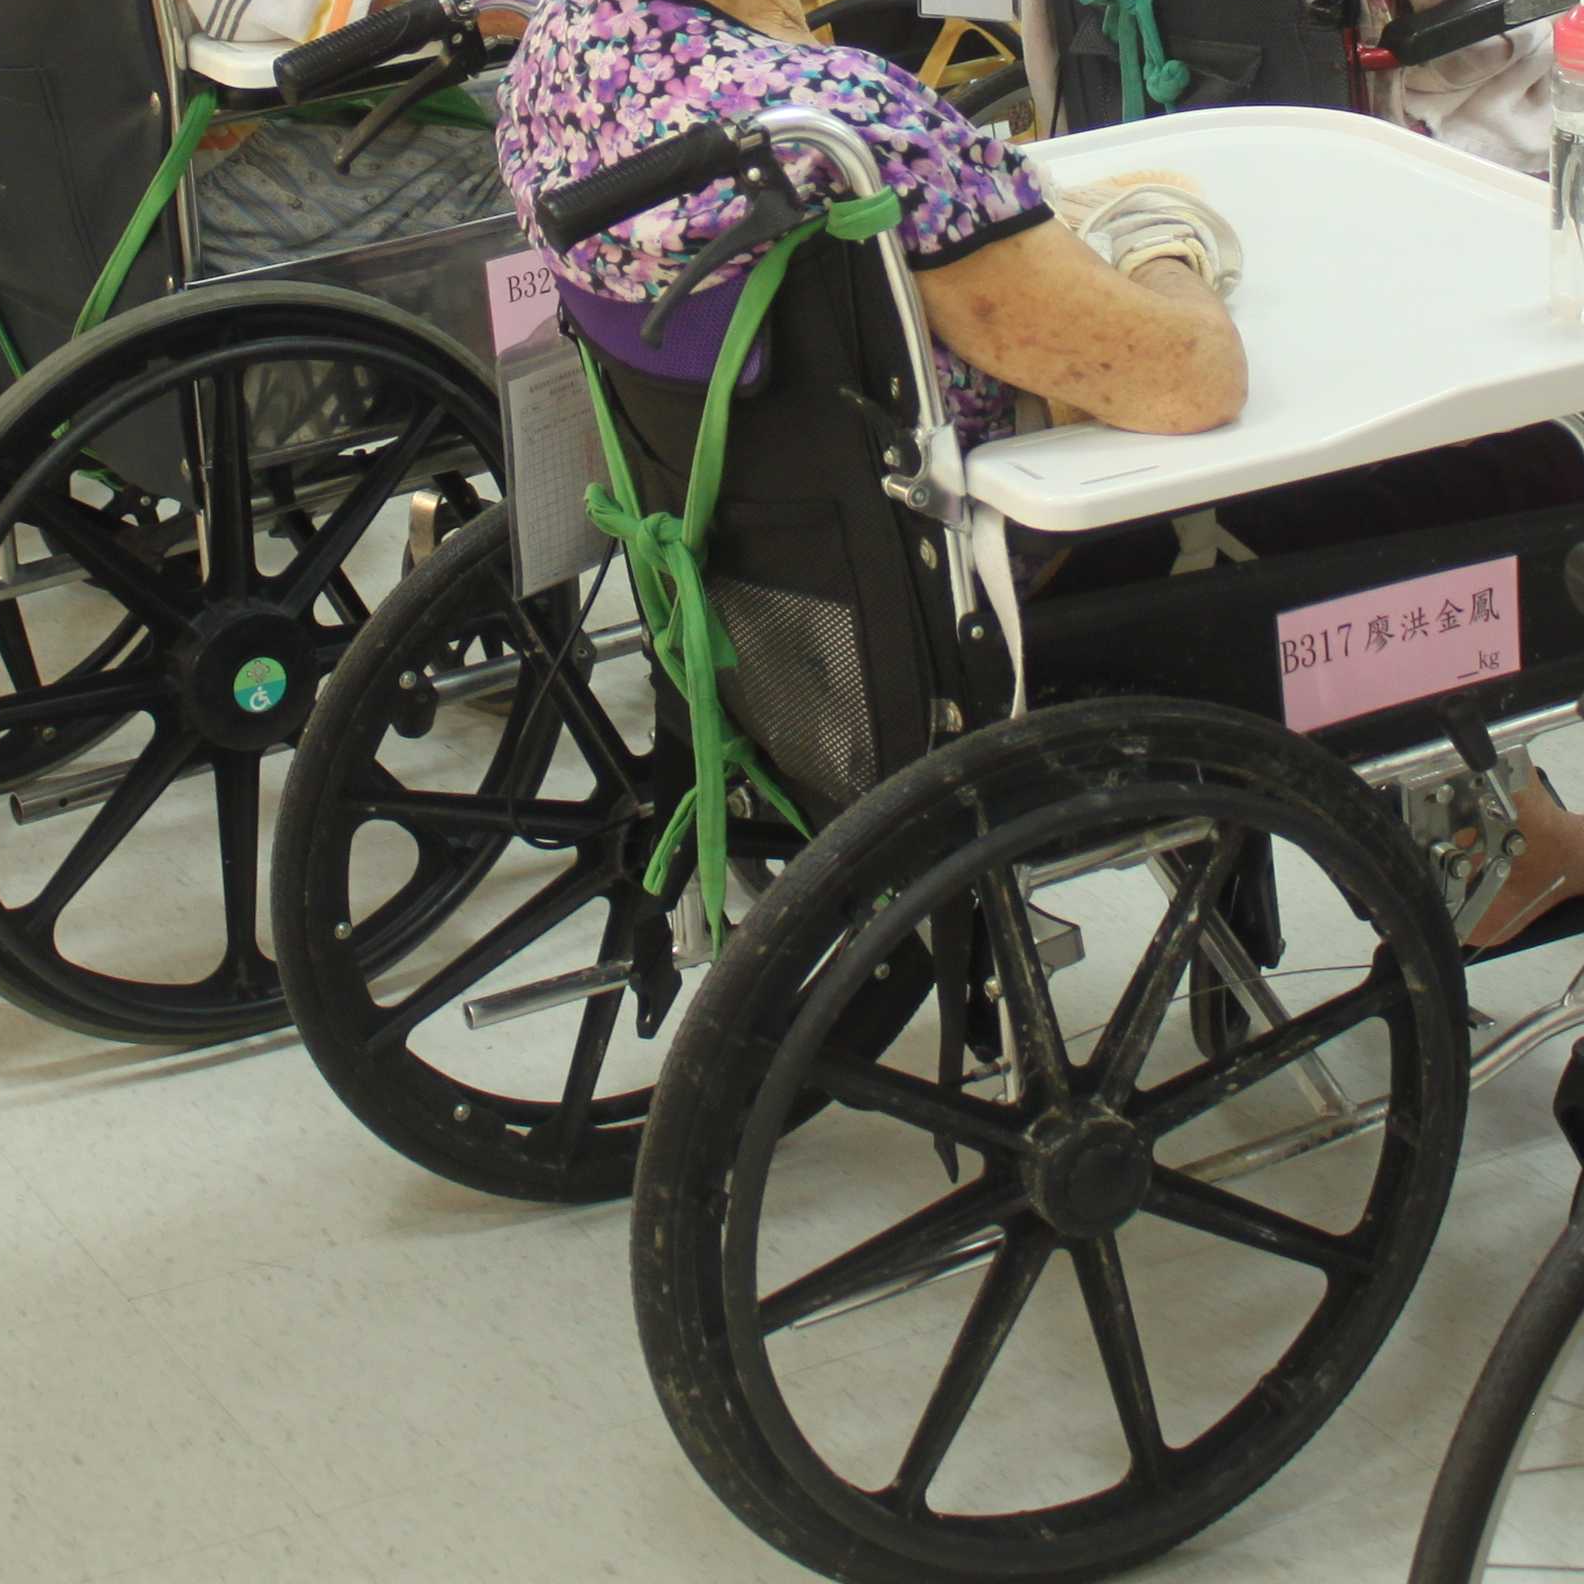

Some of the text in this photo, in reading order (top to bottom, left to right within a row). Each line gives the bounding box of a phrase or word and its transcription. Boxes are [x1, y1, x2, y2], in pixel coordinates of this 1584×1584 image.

[1280, 587, 1500, 674] B317 廖洪金鳳
